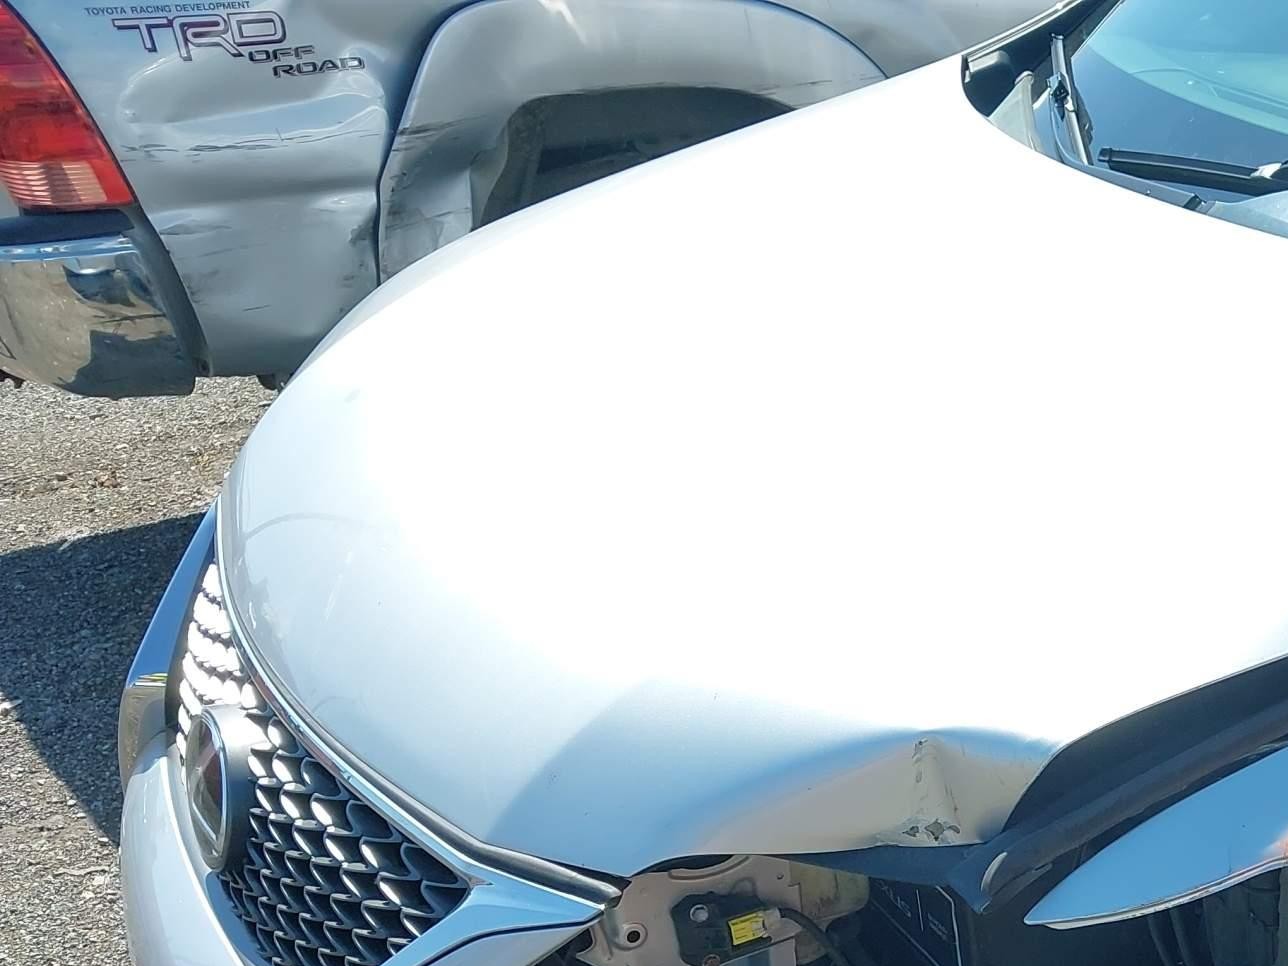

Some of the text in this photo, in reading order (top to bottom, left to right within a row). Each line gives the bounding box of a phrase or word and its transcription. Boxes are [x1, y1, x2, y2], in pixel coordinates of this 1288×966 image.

[84, 1, 252, 16] TOYOTA RACING DEVELOPMENT
[111, 10, 288, 61] TRD
[248, 45, 315, 63] OFF
[272, 56, 366, 79] ROAD
